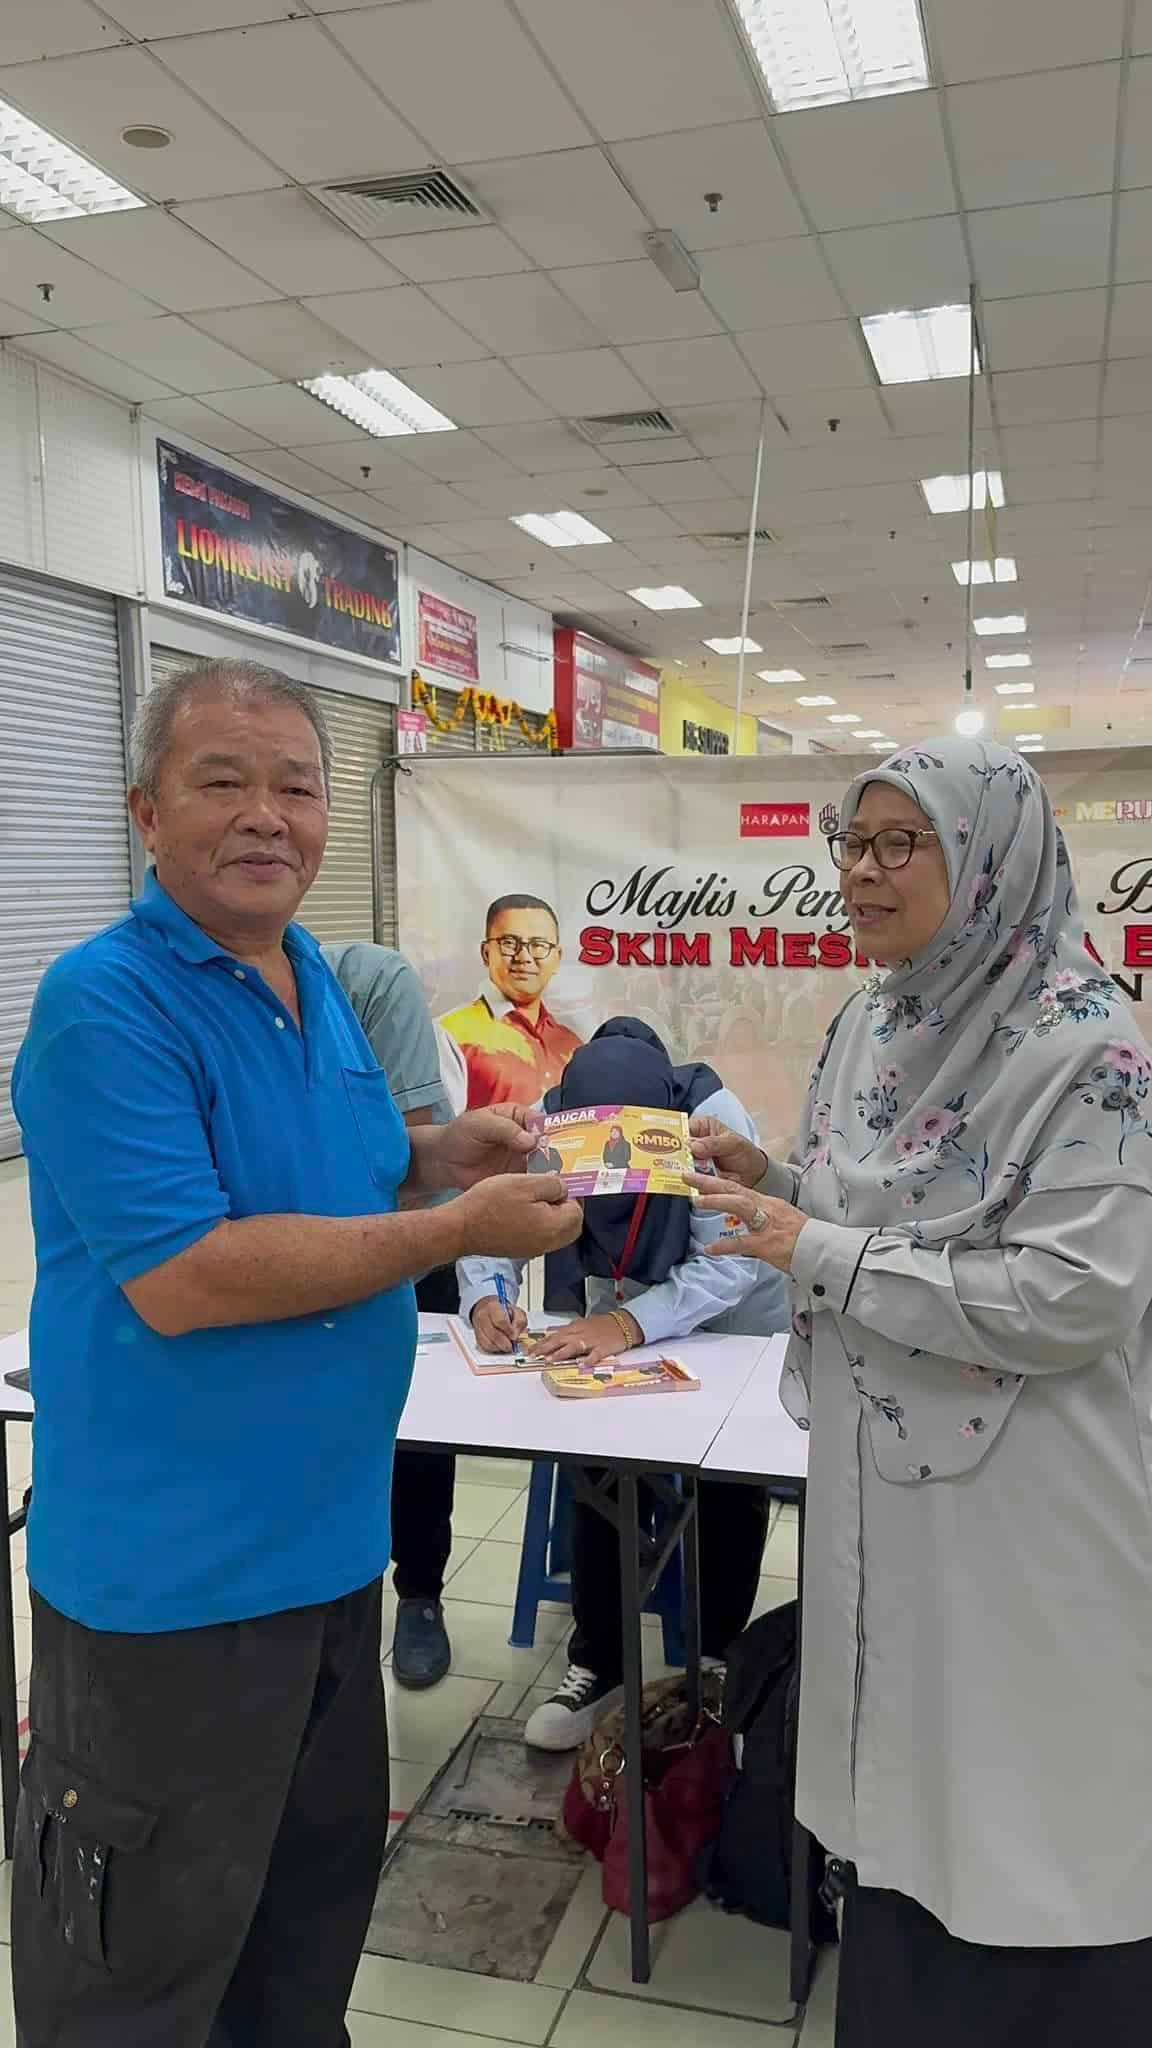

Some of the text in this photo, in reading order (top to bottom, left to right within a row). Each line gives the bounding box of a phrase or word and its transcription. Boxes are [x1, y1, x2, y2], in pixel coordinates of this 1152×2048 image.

[321, 575, 393, 629] TRADING
[740, 812, 810, 827] HARAPAN
[585, 864, 738, 930] Majlis
[578, 926, 712, 967] SKIM
[543, 1109, 597, 1126] BAUCAR
[632, 1133, 681, 1149] RM150
